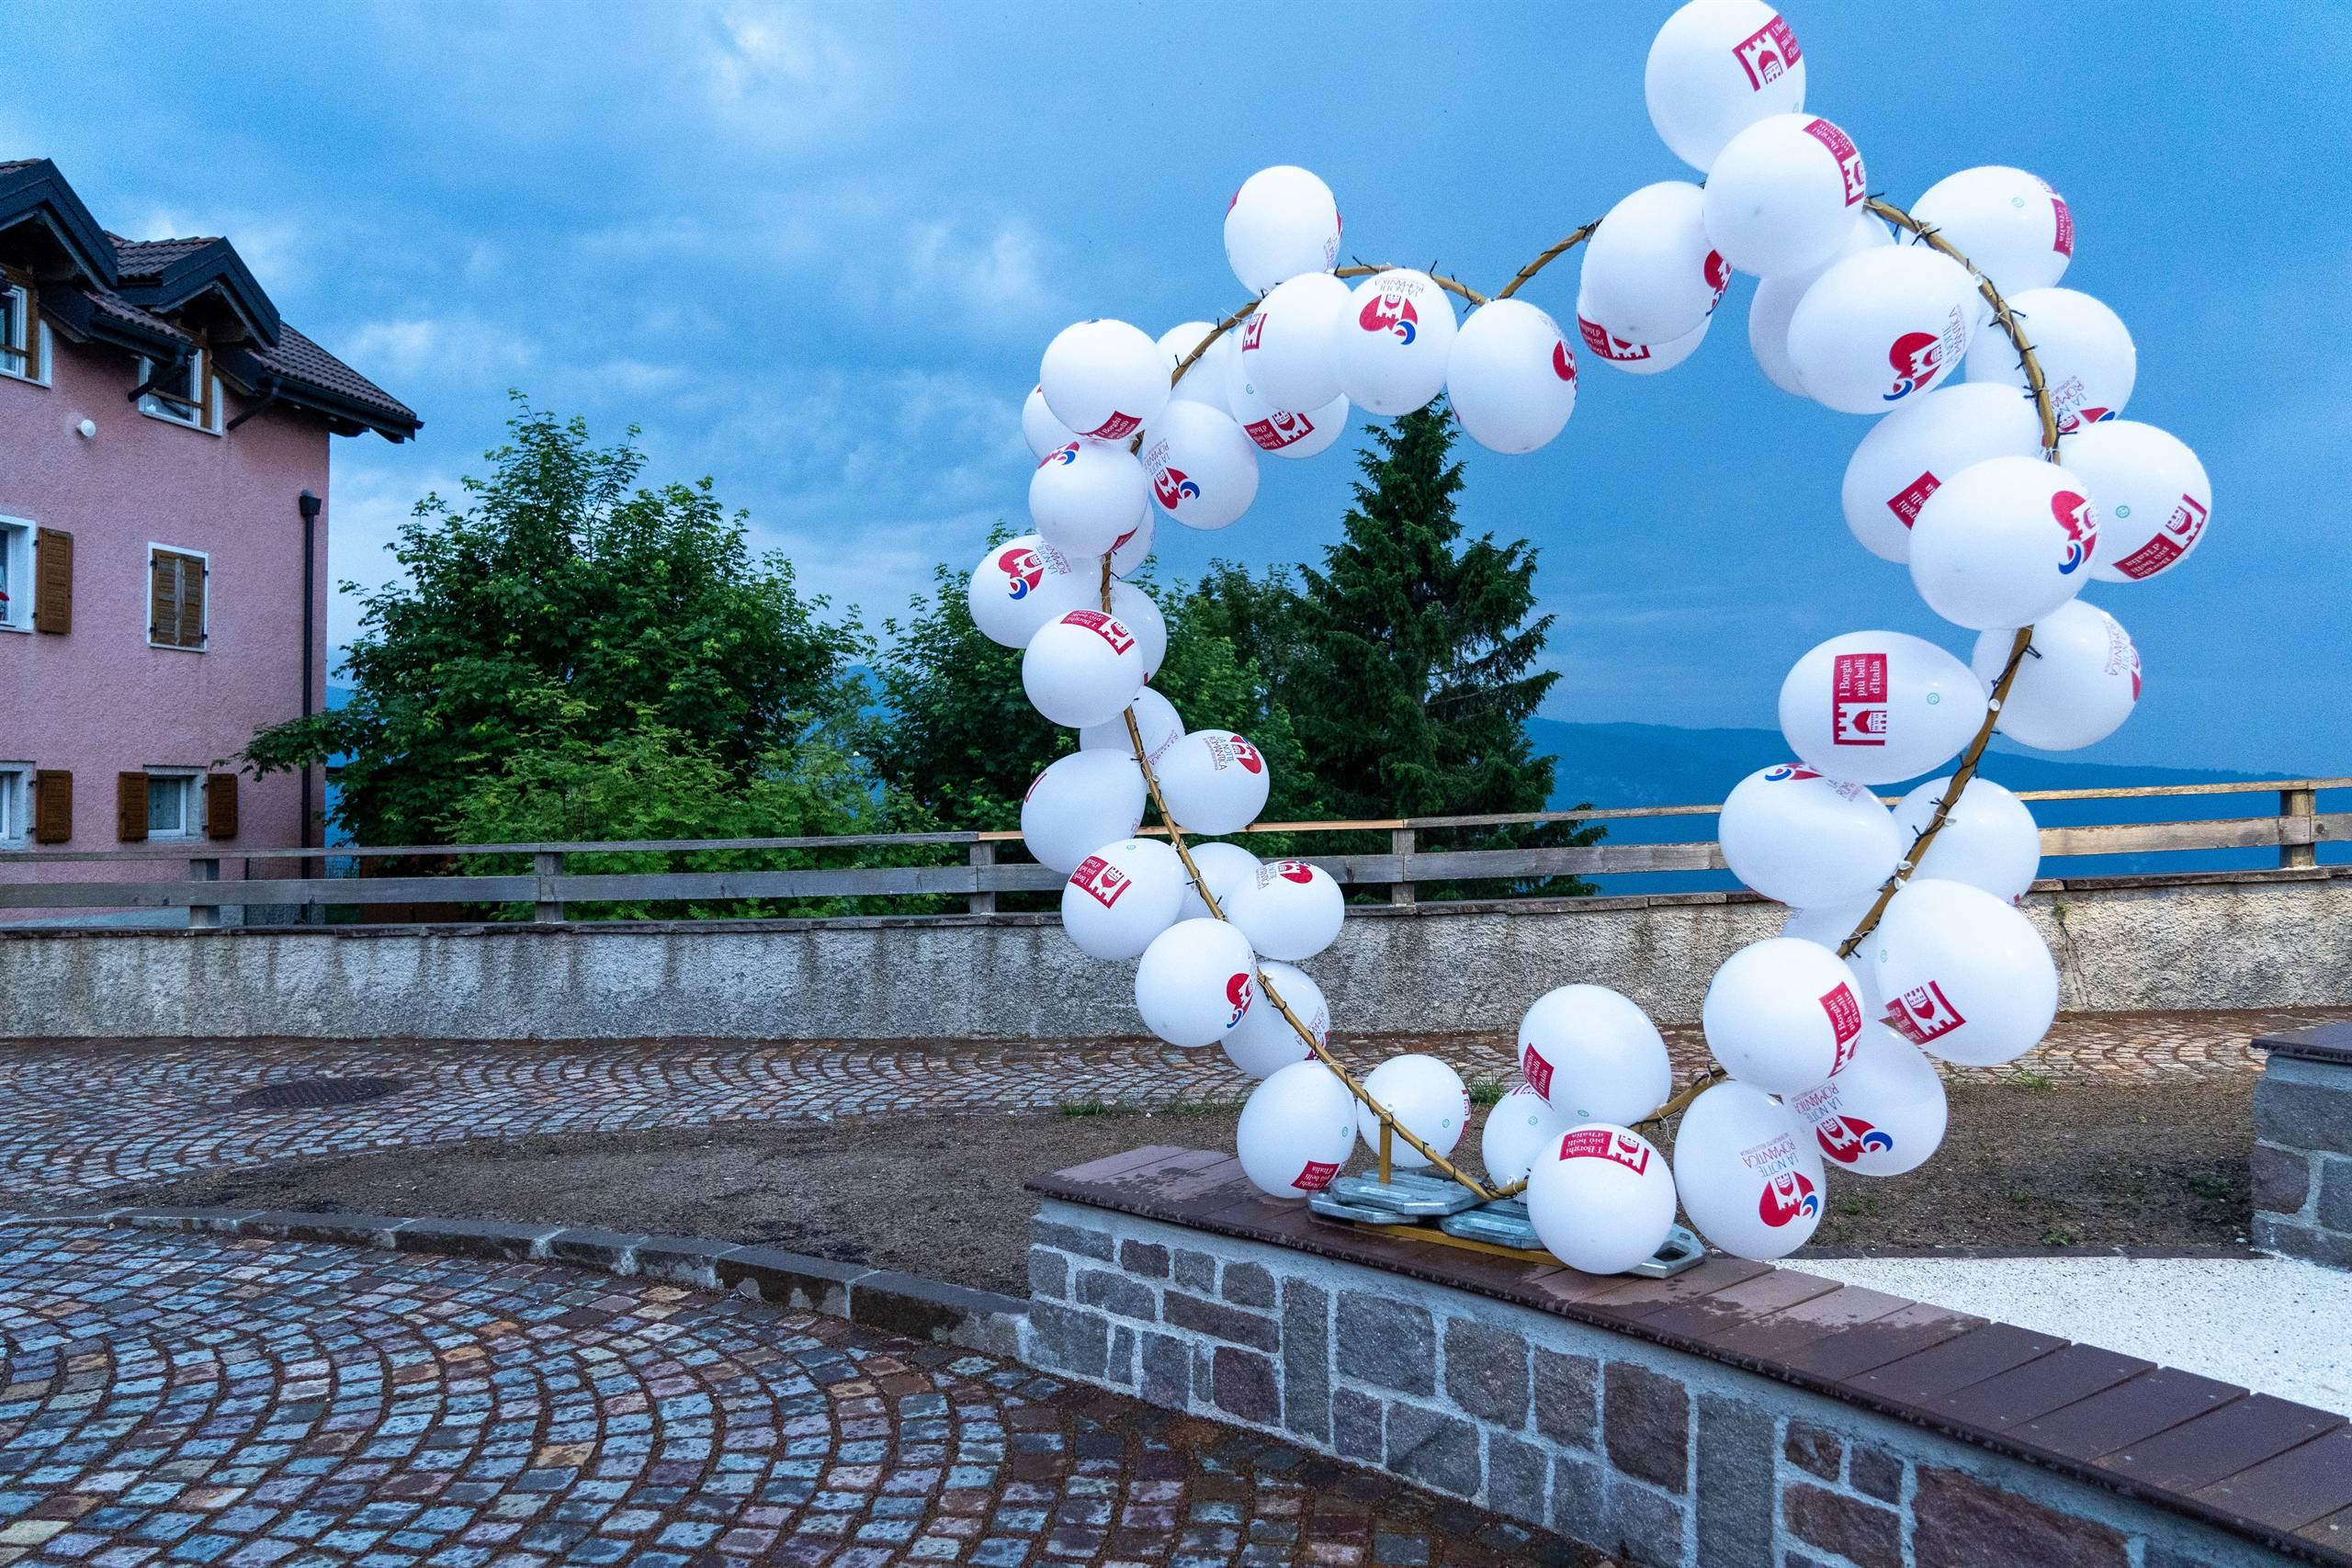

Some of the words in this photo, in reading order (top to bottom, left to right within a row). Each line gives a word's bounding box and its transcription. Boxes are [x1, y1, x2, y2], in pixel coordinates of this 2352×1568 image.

[1102, 416, 1122, 434] Borghi
[2124, 543, 2160, 567] d'Italia
[2153, 546, 2169, 560] più
[2132, 559, 2154, 574] belli
[1838, 660, 1852, 690] Borghi
[1854, 659, 1866, 678] belli
[1869, 660, 1881, 694] d'Italia
[1854, 681, 1868, 696] più
[1207, 736, 1227, 771] ROMANTICA
[1836, 994, 1850, 1016] belli
[1844, 992, 1860, 1023] d'Italia
[1826, 999, 1846, 1031] Borghi
[1846, 1015, 1856, 1032] più
[1793, 1082, 1840, 1114] ROMANTICA
[1827, 1096, 1843, 1111] LA
[1803, 1104, 1829, 1123] NOTTE
[1565, 1145, 1596, 1156] Borghi
[1567, 1138, 1587, 1147] belli
[1742, 1138, 1797, 1168] ROMANTICA
[1786, 1151, 1800, 1166] LA
[1757, 1157, 1787, 1177] NOTTE
